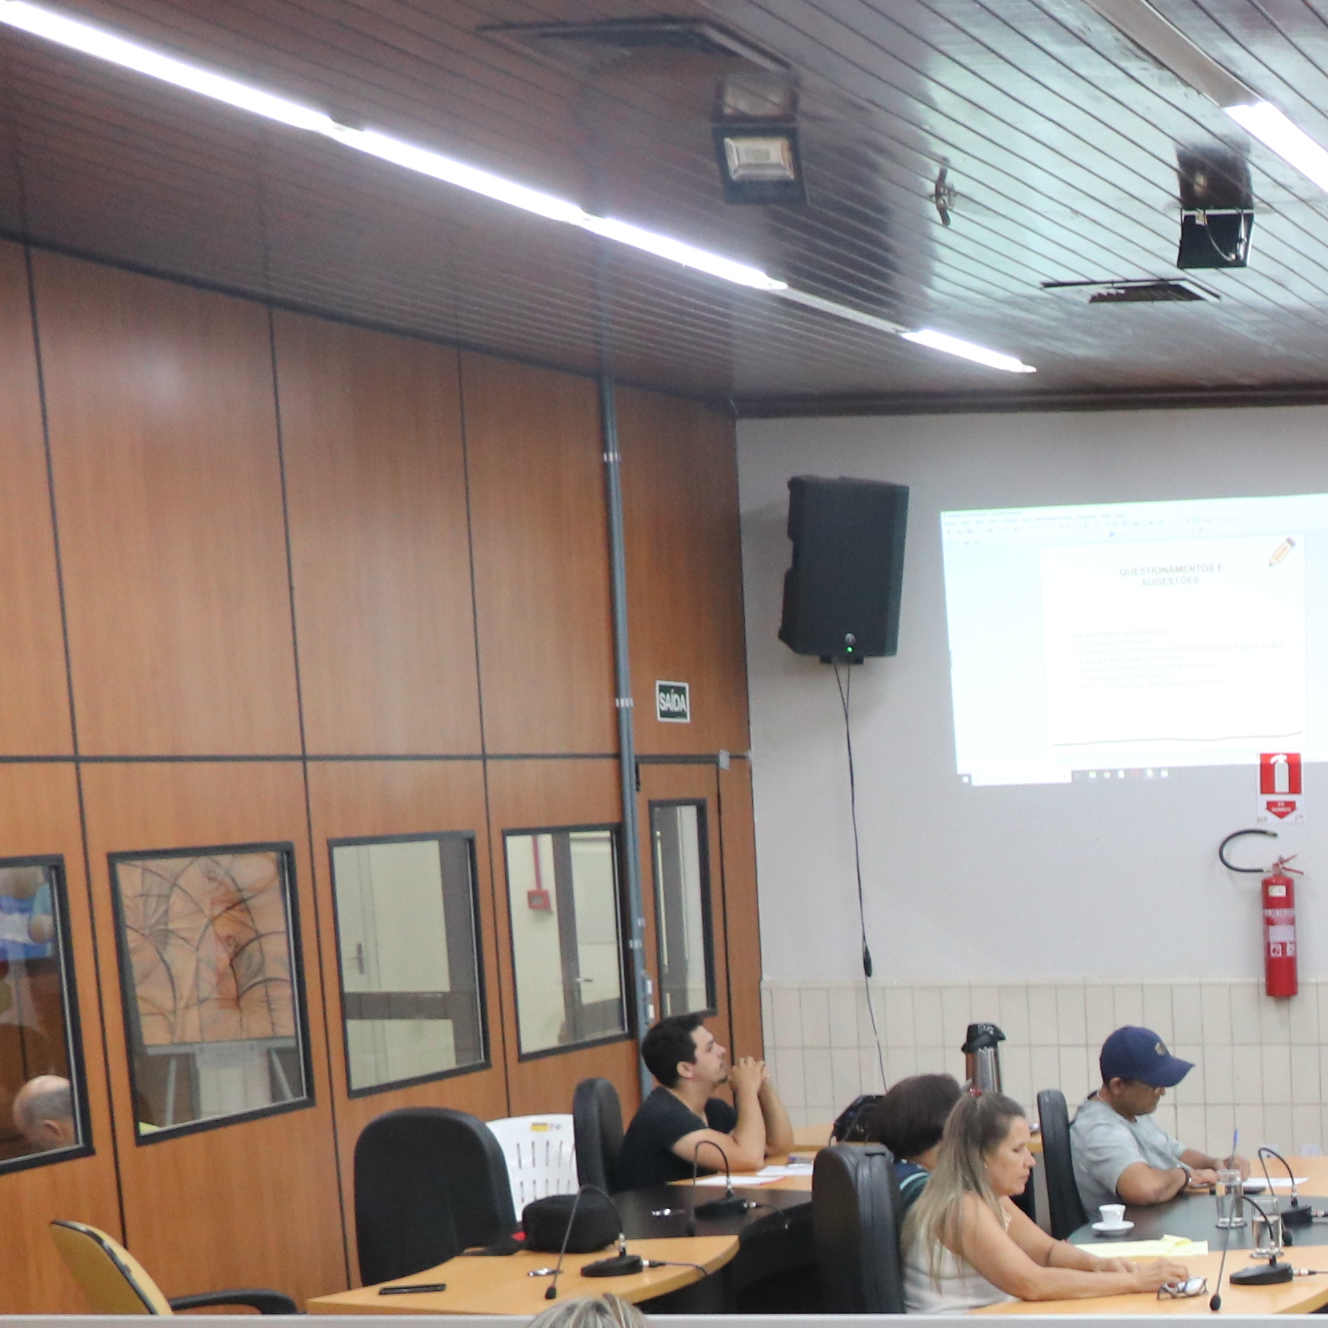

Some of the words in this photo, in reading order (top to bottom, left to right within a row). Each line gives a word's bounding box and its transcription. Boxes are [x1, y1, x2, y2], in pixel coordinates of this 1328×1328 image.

[1119, 563, 1215, 576] QUESTIONAMENTOS
[1217, 563, 1224, 572] E
[1142, 575, 1200, 587] SUGESTÕES
[659, 688, 687, 712] SAÍDA
